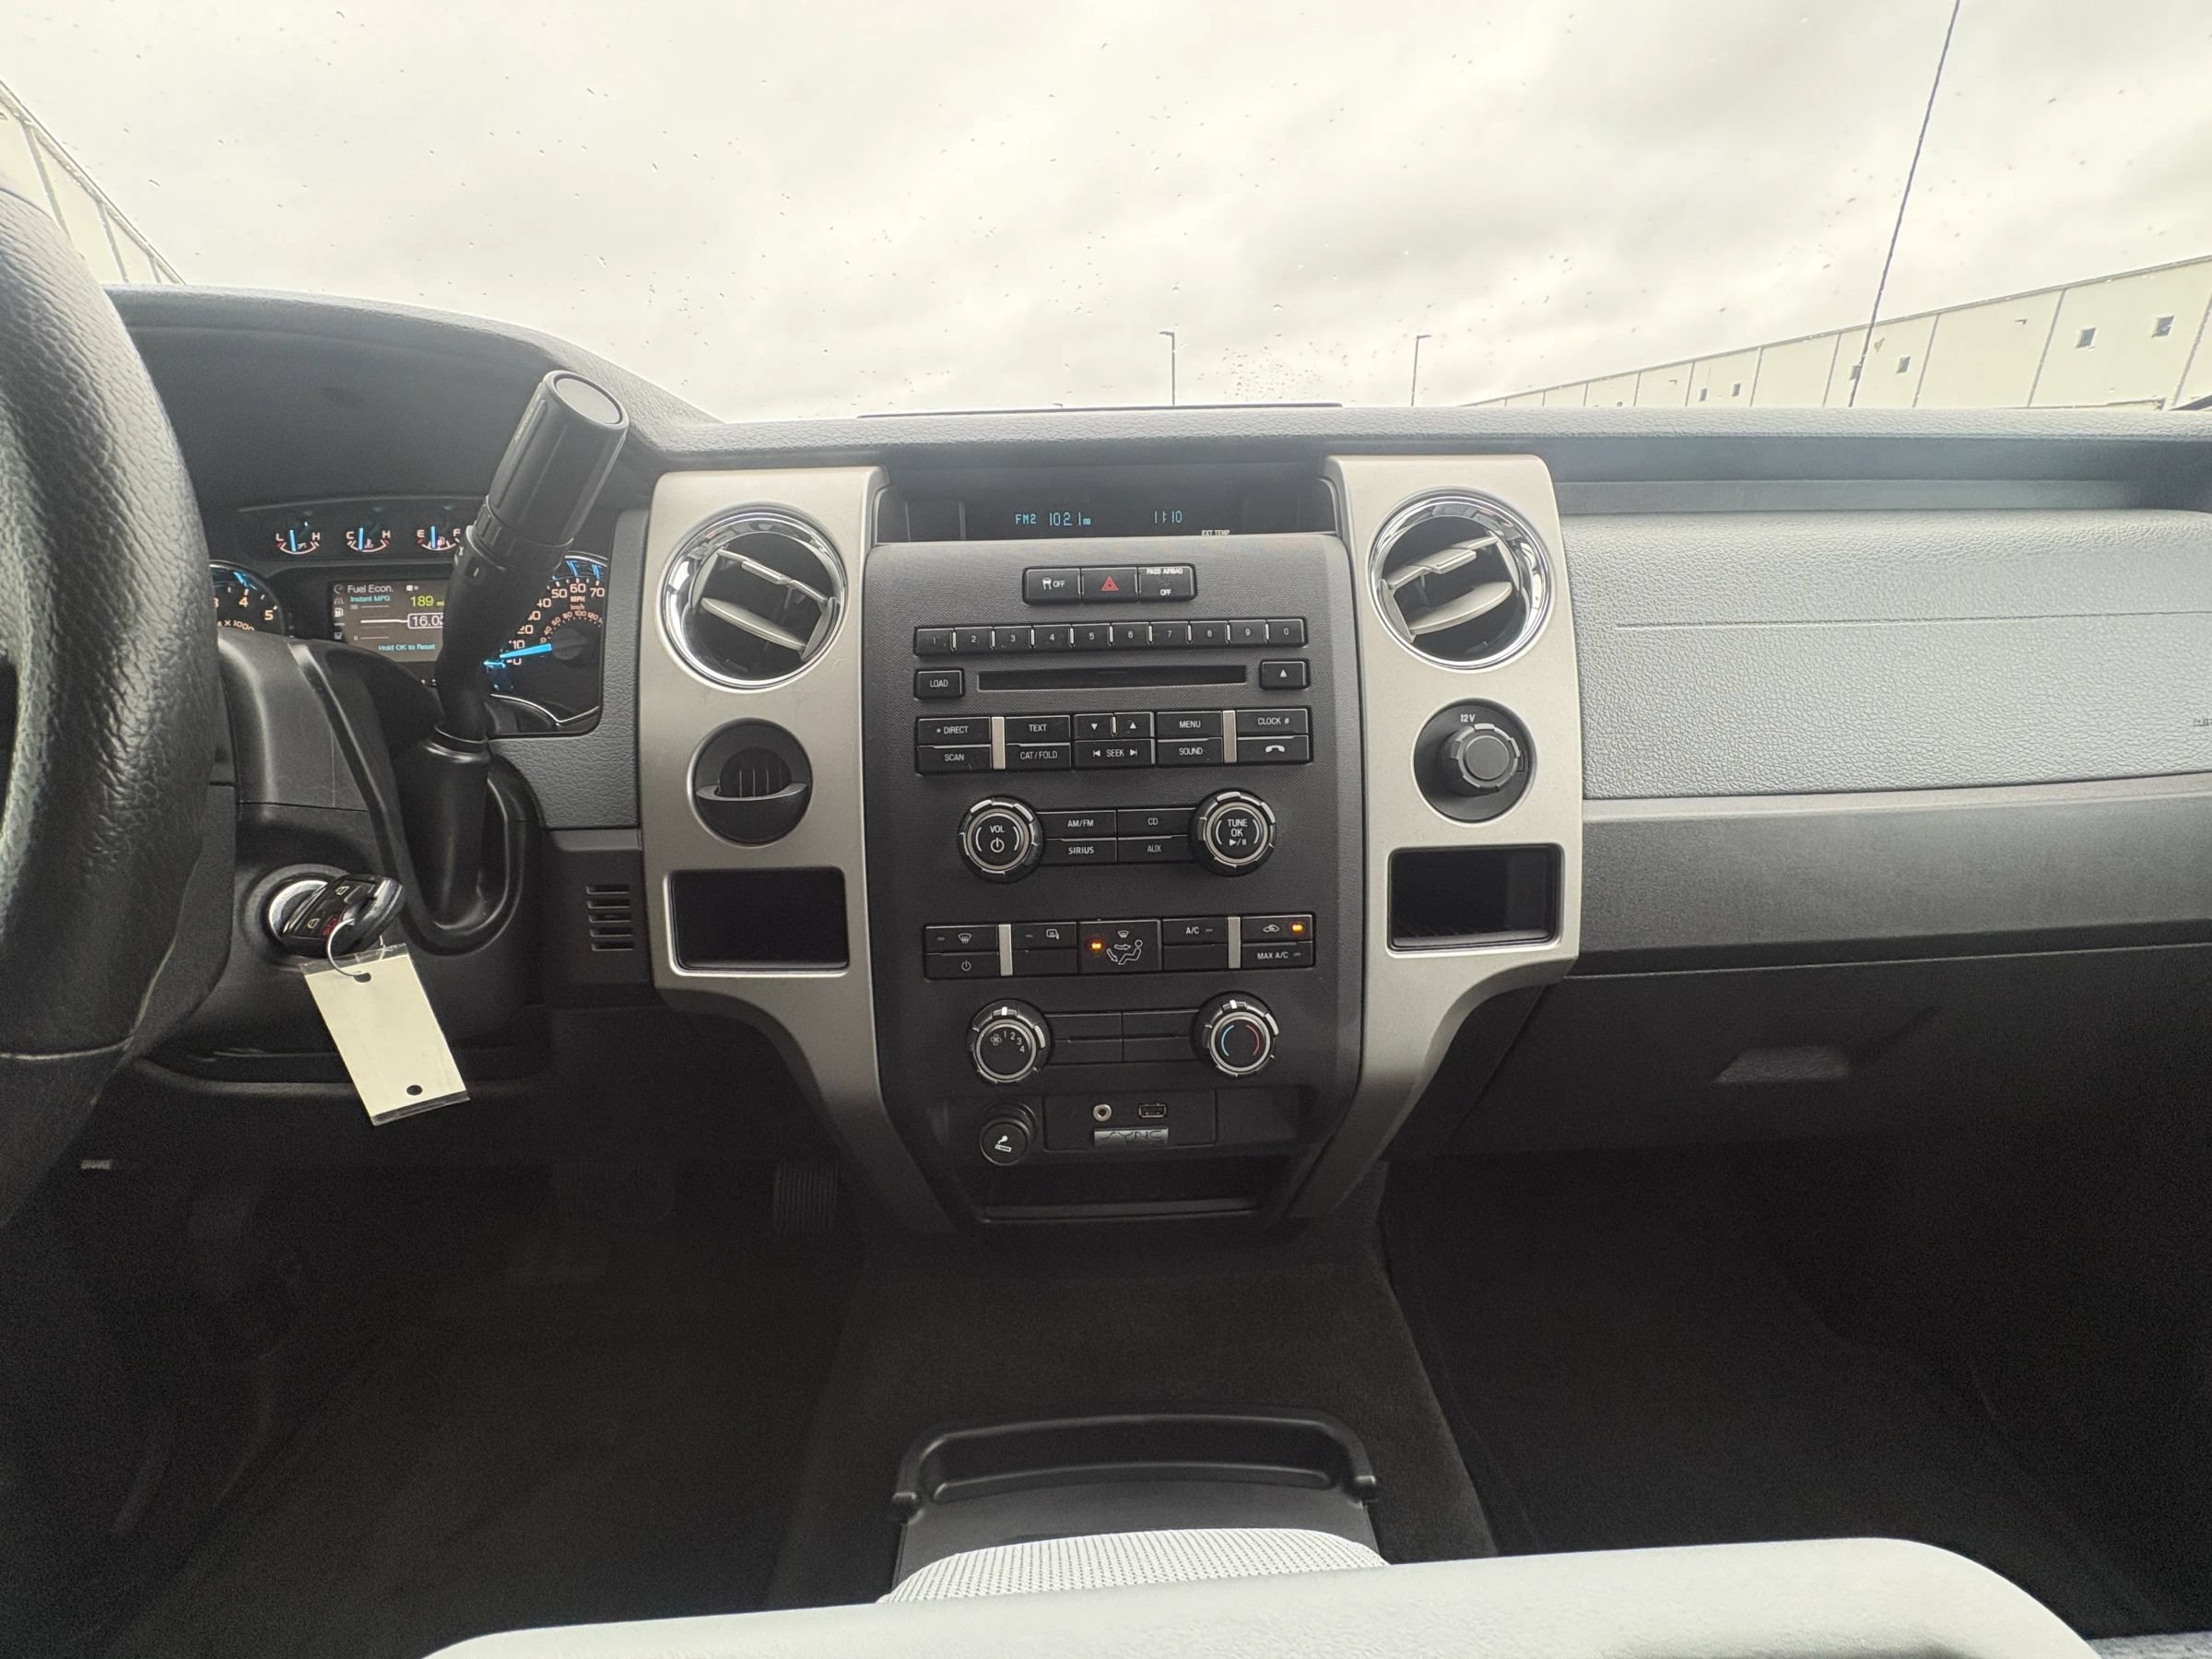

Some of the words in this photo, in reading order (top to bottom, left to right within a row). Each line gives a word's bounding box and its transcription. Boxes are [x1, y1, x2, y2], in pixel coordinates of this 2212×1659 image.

[1015, 513, 1037, 524] FM2
[276, 533, 284, 541] L
[312, 532, 321, 541] H
[346, 531, 355, 540] C
[382, 530, 391, 539] H
[417, 529, 425, 538] E
[453, 528, 461, 537] F
[347, 584, 367, 594] Fuel
[368, 583, 394, 593] Econ.
[570, 582, 586, 594] 60
[1053, 581, 1065, 589] OFF
[551, 588, 568, 599] 50
[590, 587, 606, 598] 70
[1159, 588, 1172, 596] OFF
[238, 596, 249, 608] 4
[410, 595, 434, 607] 189
[264, 609, 275, 621] 5
[1127, 630, 1134, 639] 6
[1167, 629, 1172, 638] 7
[1206, 629, 1213, 638] 8
[1244, 628, 1252, 636] 9
[1283, 627, 1289, 636] 0
[971, 635, 977, 643] 2
[1010, 634, 1016, 642] 3
[1049, 633, 1054, 641] 4
[929, 679, 948, 688] LOAD
[1257, 717, 1281, 725] CLOCK
[1460, 713, 1476, 723] 12V
[1029, 724, 1047, 733] TEXT
[1179, 720, 1201, 729] MENU
[943, 726, 969, 735] DIRECT
[1106, 748, 1124, 758] SEEK
[1178, 747, 1203, 756] SOUND
[944, 753, 965, 762] SCAN
[1067, 819, 1095, 829] AM/FM
[1147, 818, 1159, 826] CD
[1227, 818, 1248, 828] TUNE
[989, 825, 1006, 833] VOL
[1230, 828, 1243, 838] OK
[1067, 846, 1095, 855] SIRIUS
[1147, 844, 1162, 853] AUX
[1185, 926, 1200, 935] A/C
[1009, 1031, 1016, 1041] 2
[1016, 1037, 1022, 1046] 3
[1019, 1045, 1025, 1053] 4
